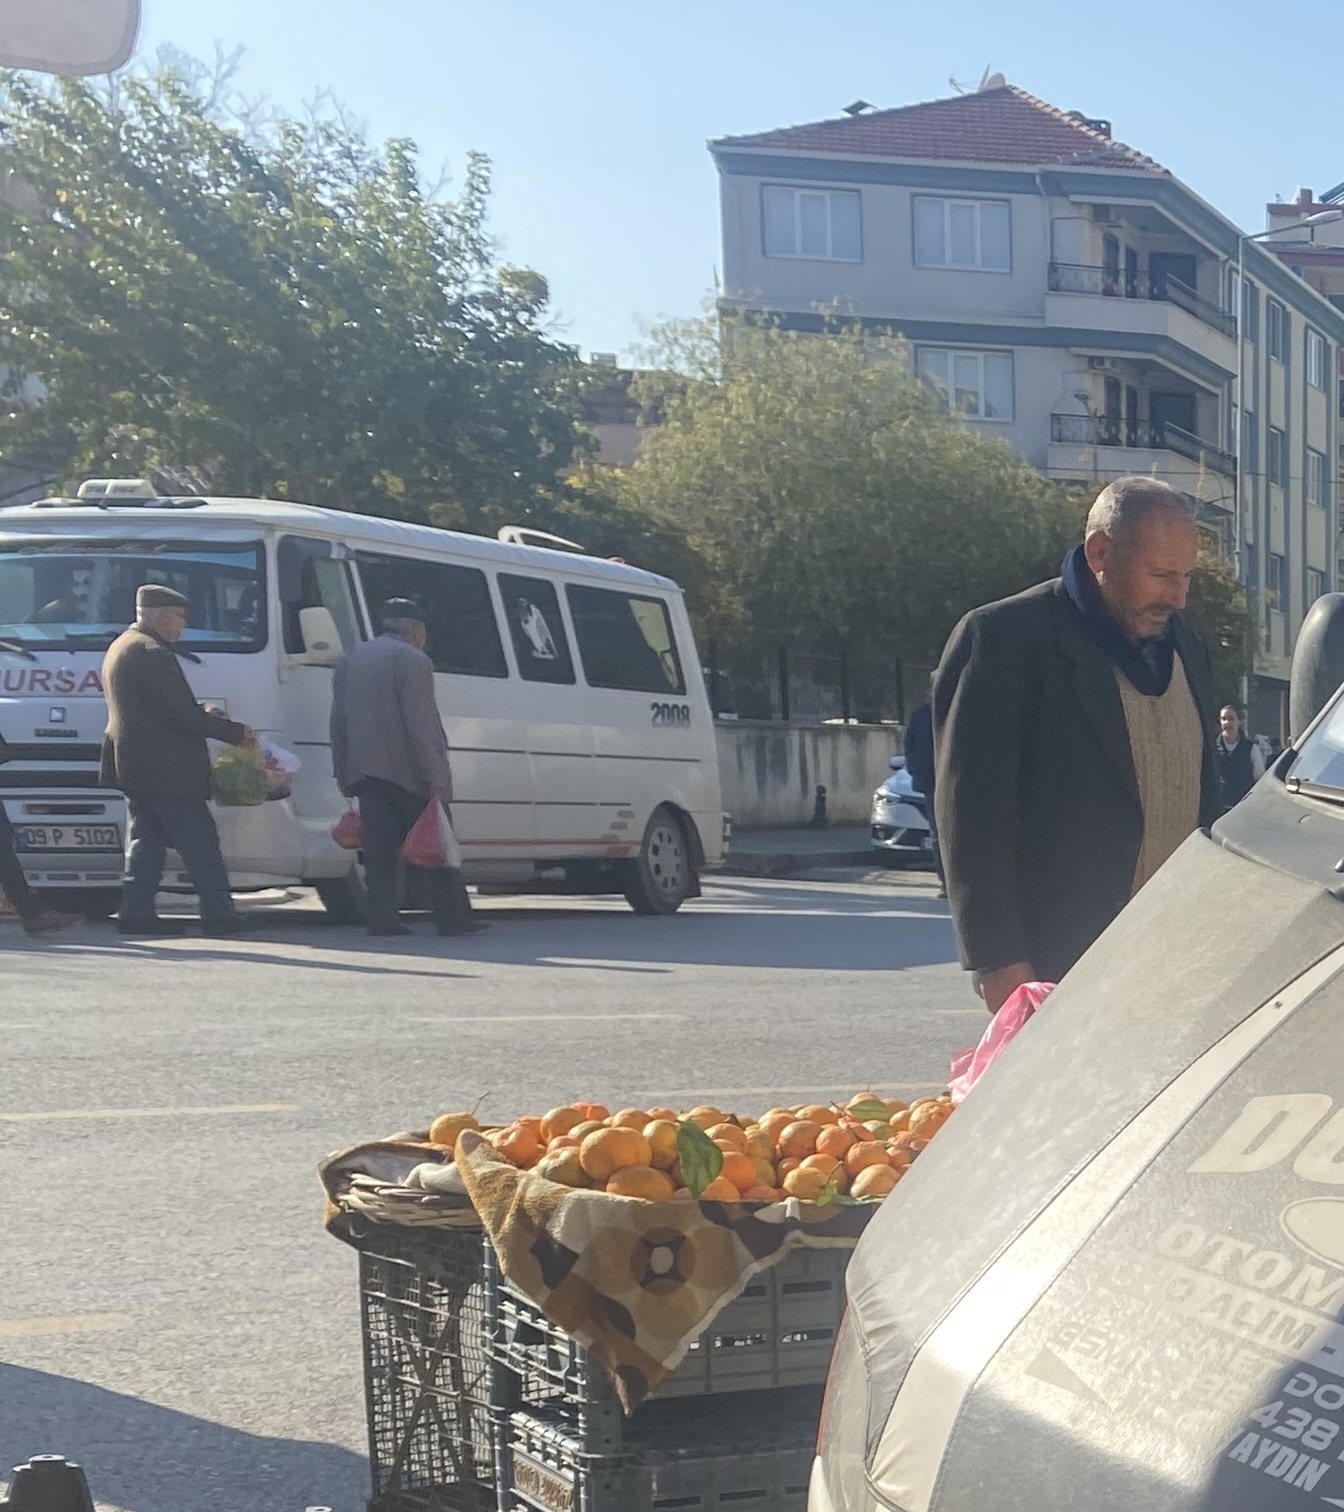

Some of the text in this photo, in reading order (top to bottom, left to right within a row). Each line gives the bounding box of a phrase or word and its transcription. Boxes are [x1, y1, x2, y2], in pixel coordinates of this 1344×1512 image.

[0, 669, 104, 693] URSA
[650, 702, 691, 728] 2008
[27, 828, 116, 846] 09 P 5102
[1197, 1291, 1318, 1350] ALIM
[1249, 1400, 1340, 1451] 438
